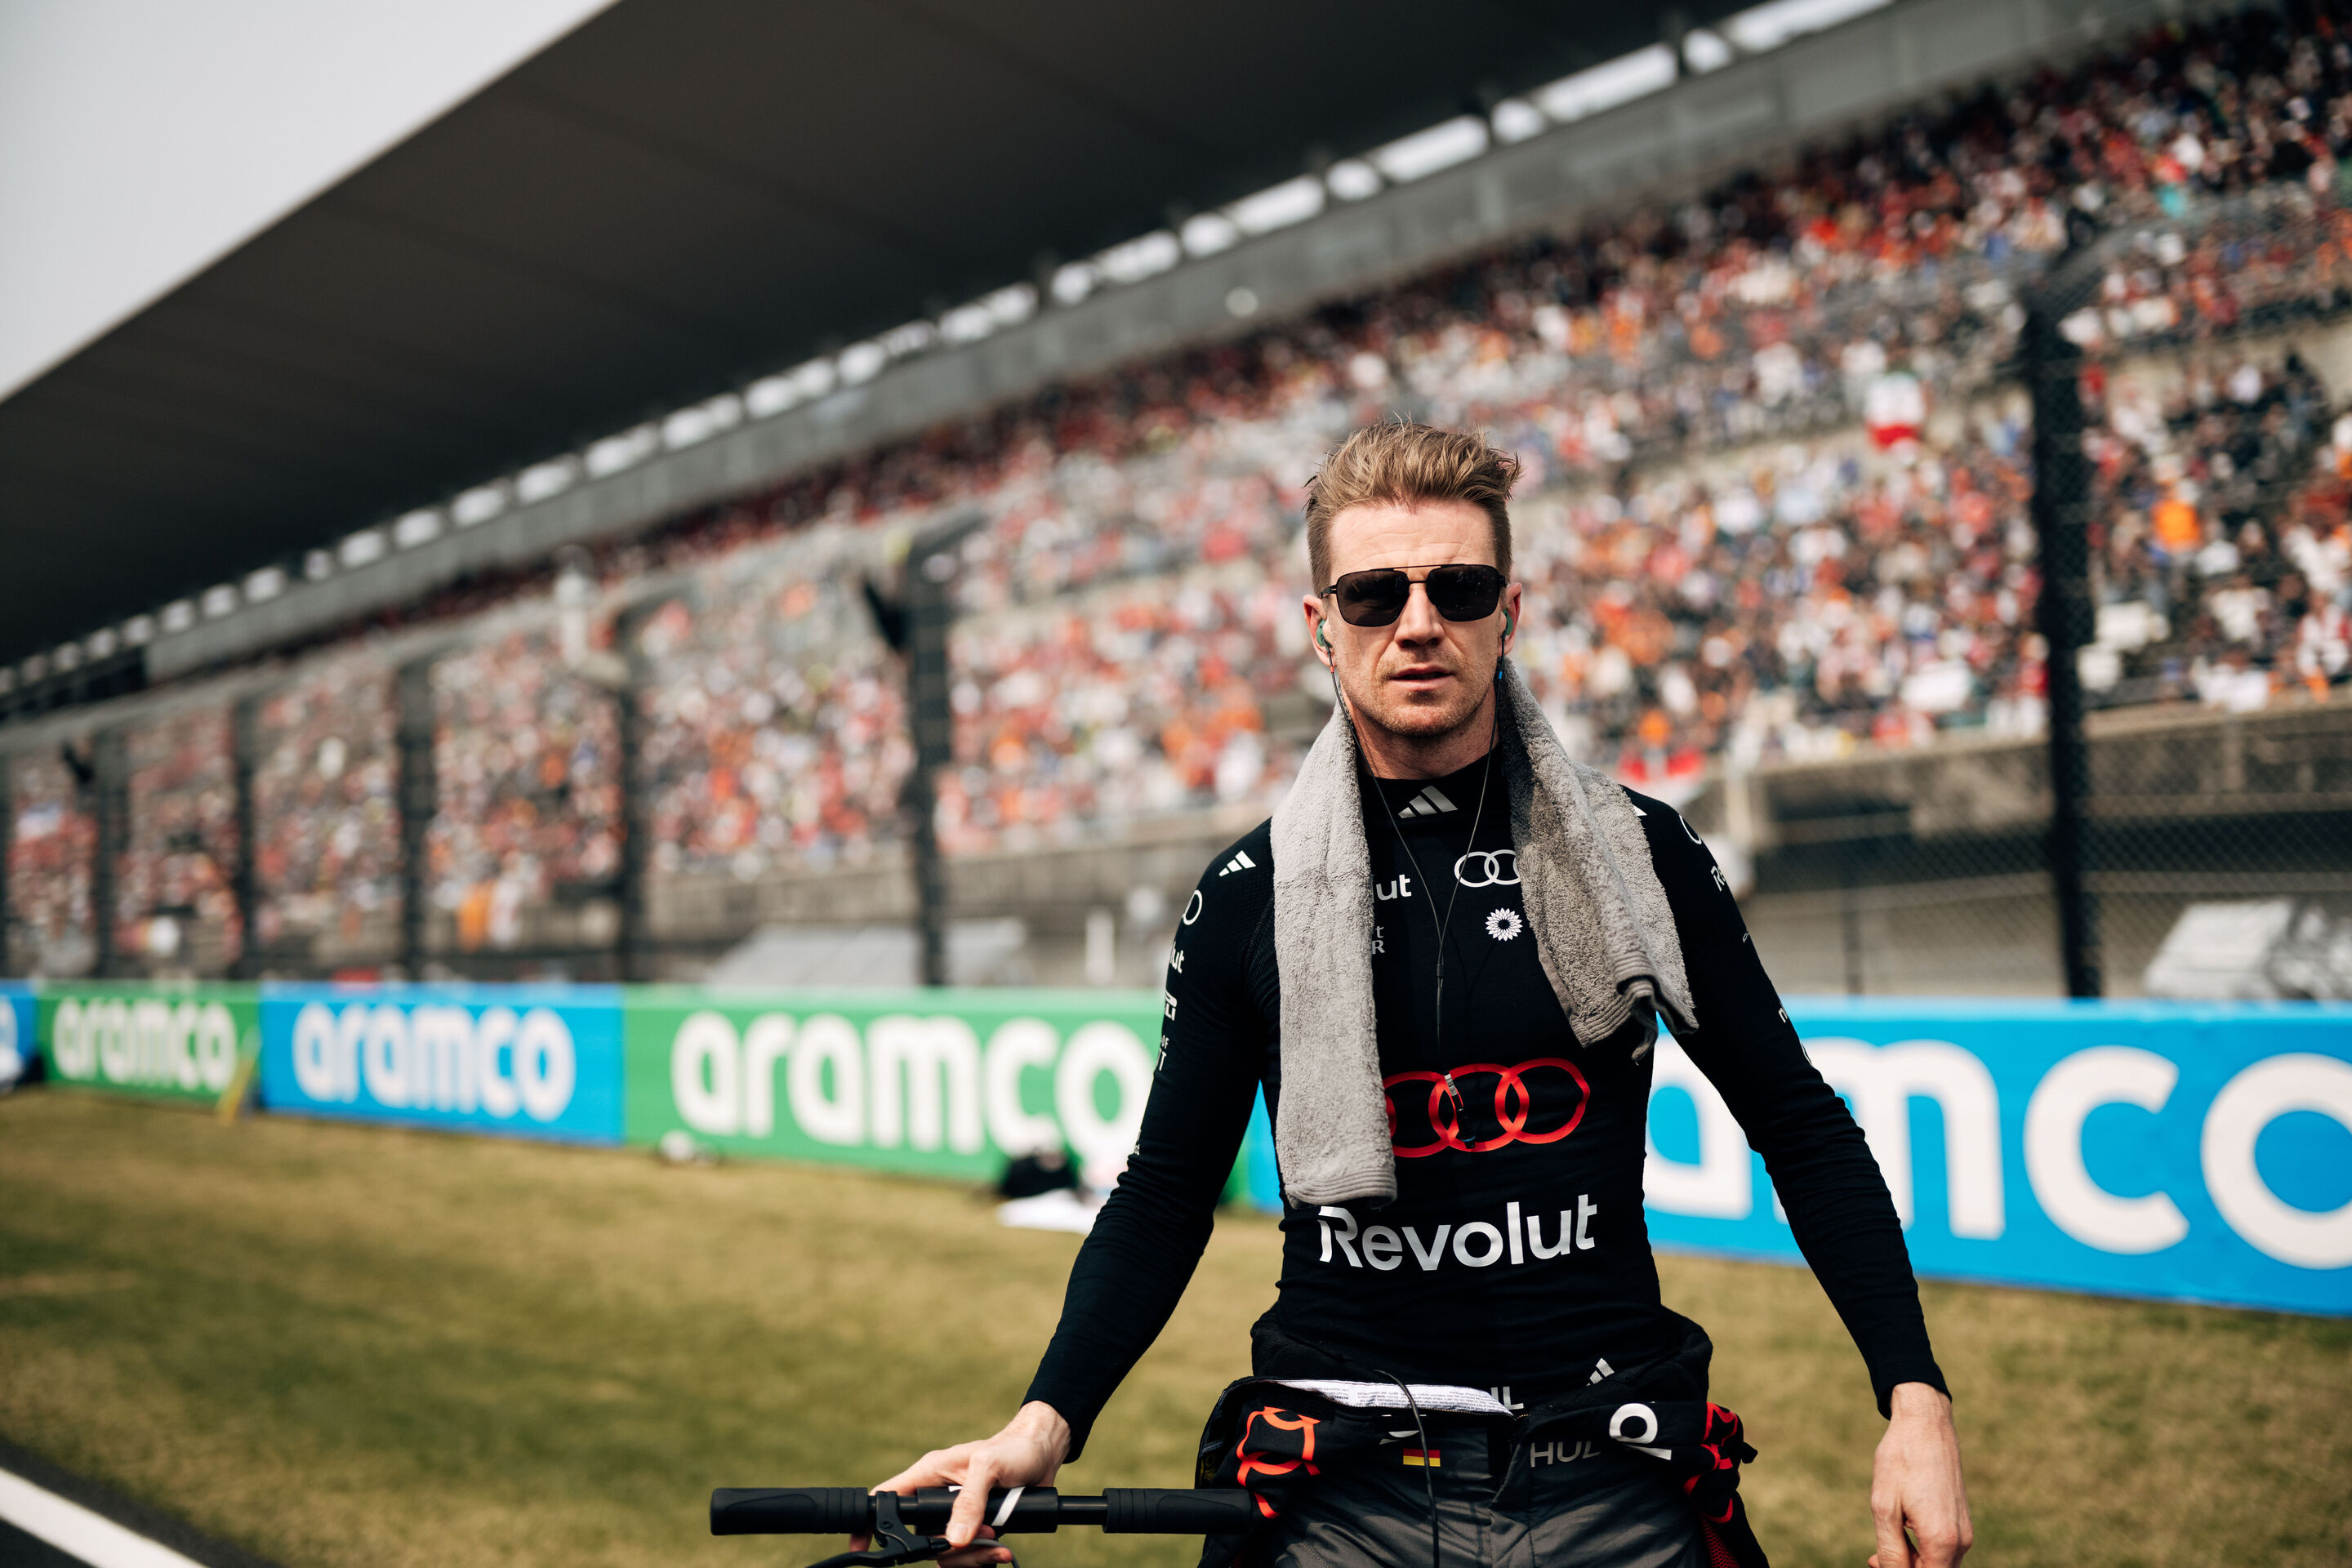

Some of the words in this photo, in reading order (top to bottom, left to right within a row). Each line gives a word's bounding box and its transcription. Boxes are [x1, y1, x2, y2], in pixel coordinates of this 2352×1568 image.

[52, 996, 238, 1092] aramco
[292, 1001, 577, 1123] aramco
[671, 1010, 1154, 1173] aramco
[1644, 1036, 2352, 1270] amco
[1317, 1194, 1597, 1271] Revolut
[1530, 1440, 1601, 1468] HUL
